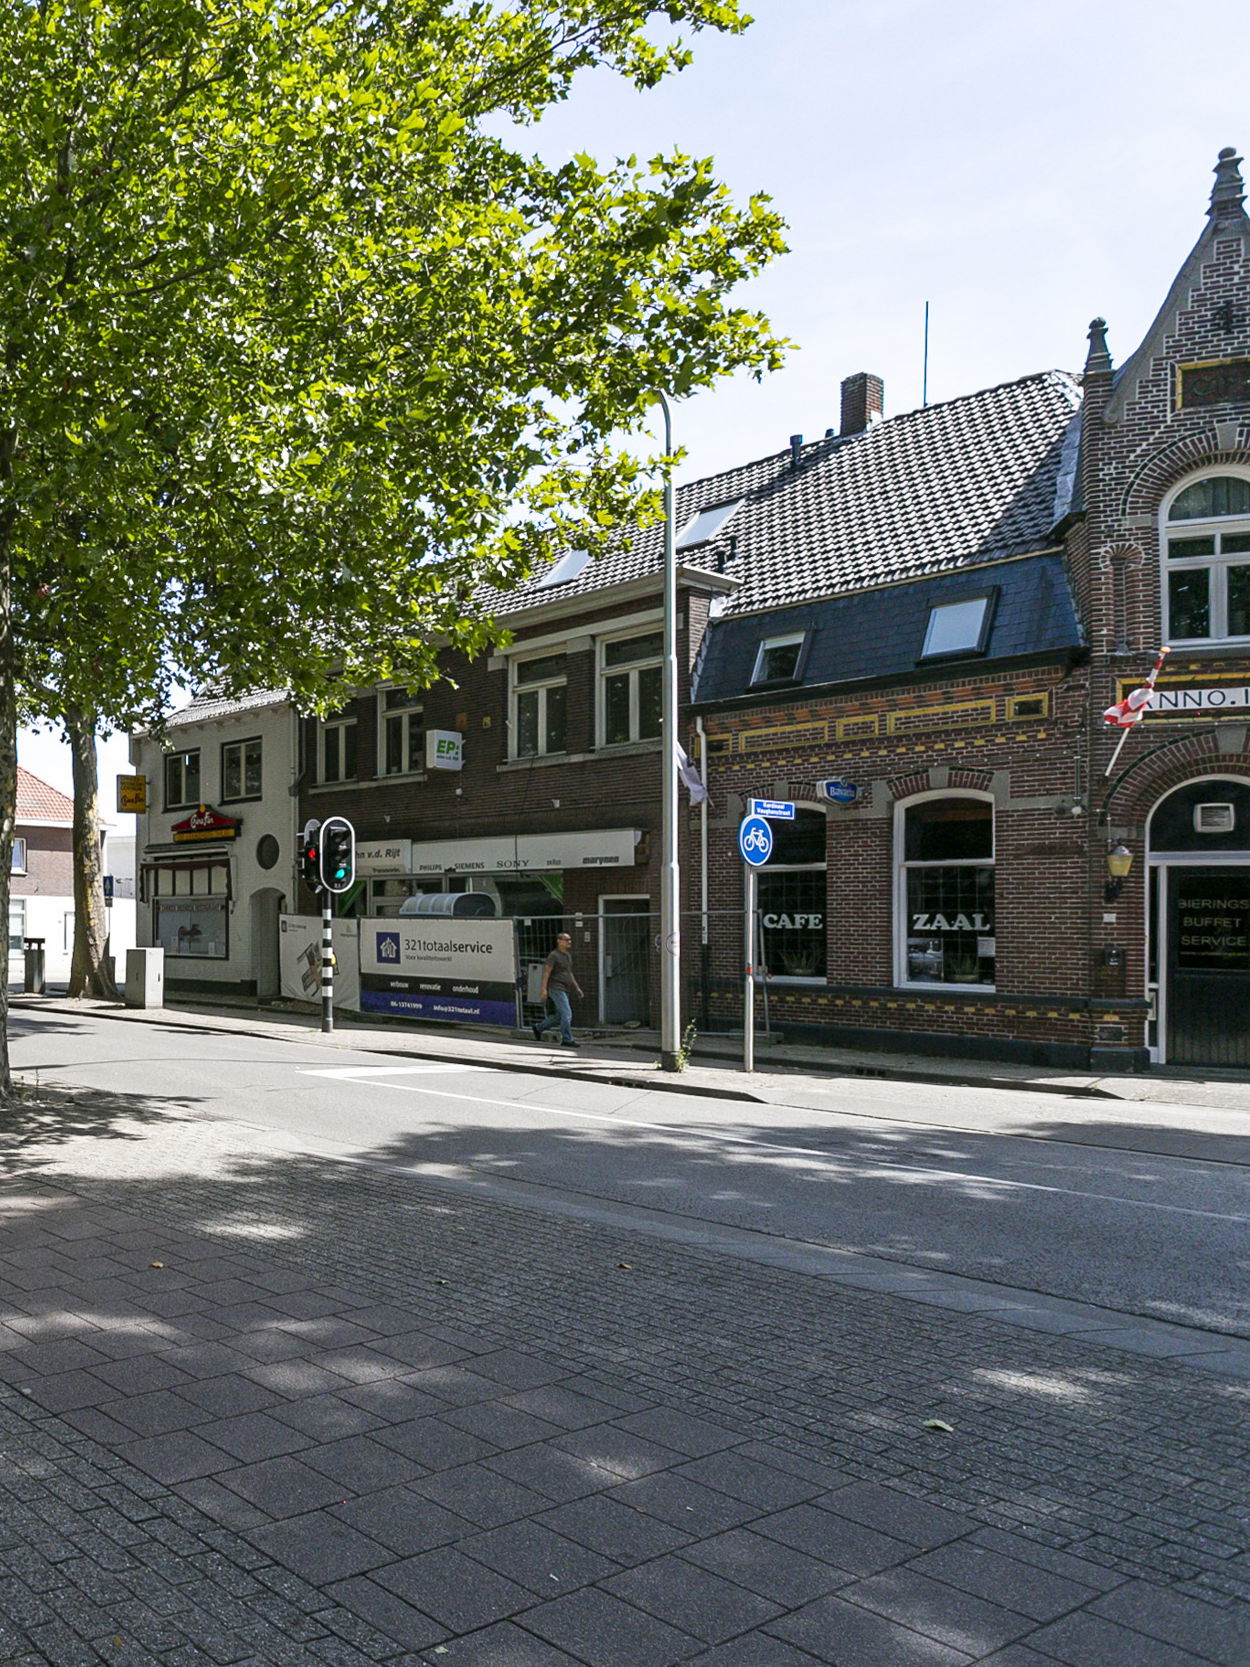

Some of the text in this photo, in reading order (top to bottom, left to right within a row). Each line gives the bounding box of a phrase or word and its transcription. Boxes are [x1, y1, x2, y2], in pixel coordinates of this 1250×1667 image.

[436, 739, 459, 755] EP:
[830, 786, 854, 796] Bavaria
[757, 807, 790, 816] Vaughanstraat
[367, 849, 382, 858] v.d.
[385, 848, 401, 859] Rijt
[419, 863, 442, 871] PHILIPS
[455, 862, 485, 870] SIEMENS
[496, 859, 530, 868] SONY
[1178, 898, 1250, 909] BIERINGS
[763, 914, 823, 929] CAFE
[913, 914, 990, 930] ZAAL
[1183, 917, 1242, 927] BUFFET
[1181, 935, 1247, 946] SERVICE
[404, 939, 493, 954] 321totaalservice
[452, 985, 479, 993] onderhoud
